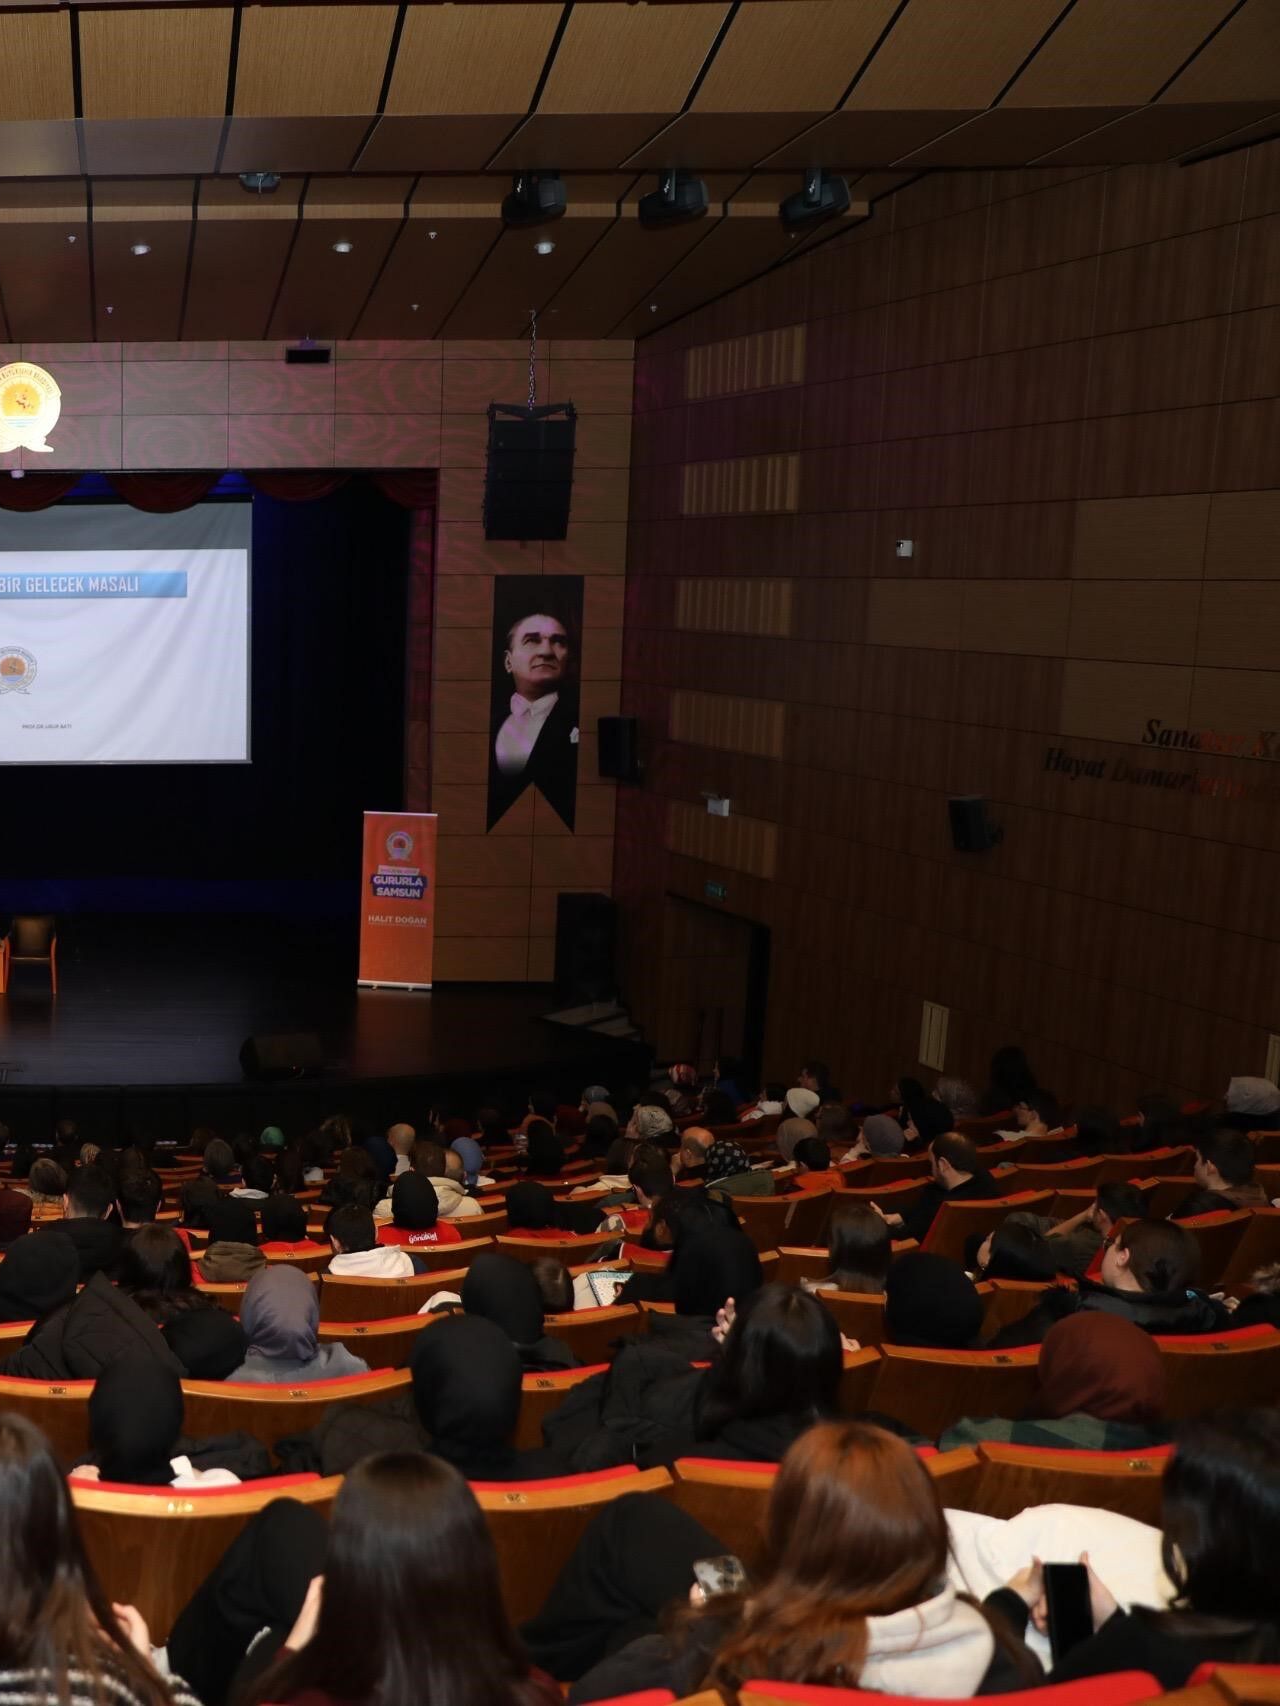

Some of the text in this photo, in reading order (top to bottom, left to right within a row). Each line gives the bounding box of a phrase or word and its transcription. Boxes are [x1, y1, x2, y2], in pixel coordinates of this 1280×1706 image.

[25, 576, 84, 592] GELECEK
[88, 575, 139, 592] MASALI
[372, 875, 423, 887] GURURLA
[376, 887, 421, 898] SAMSUN
